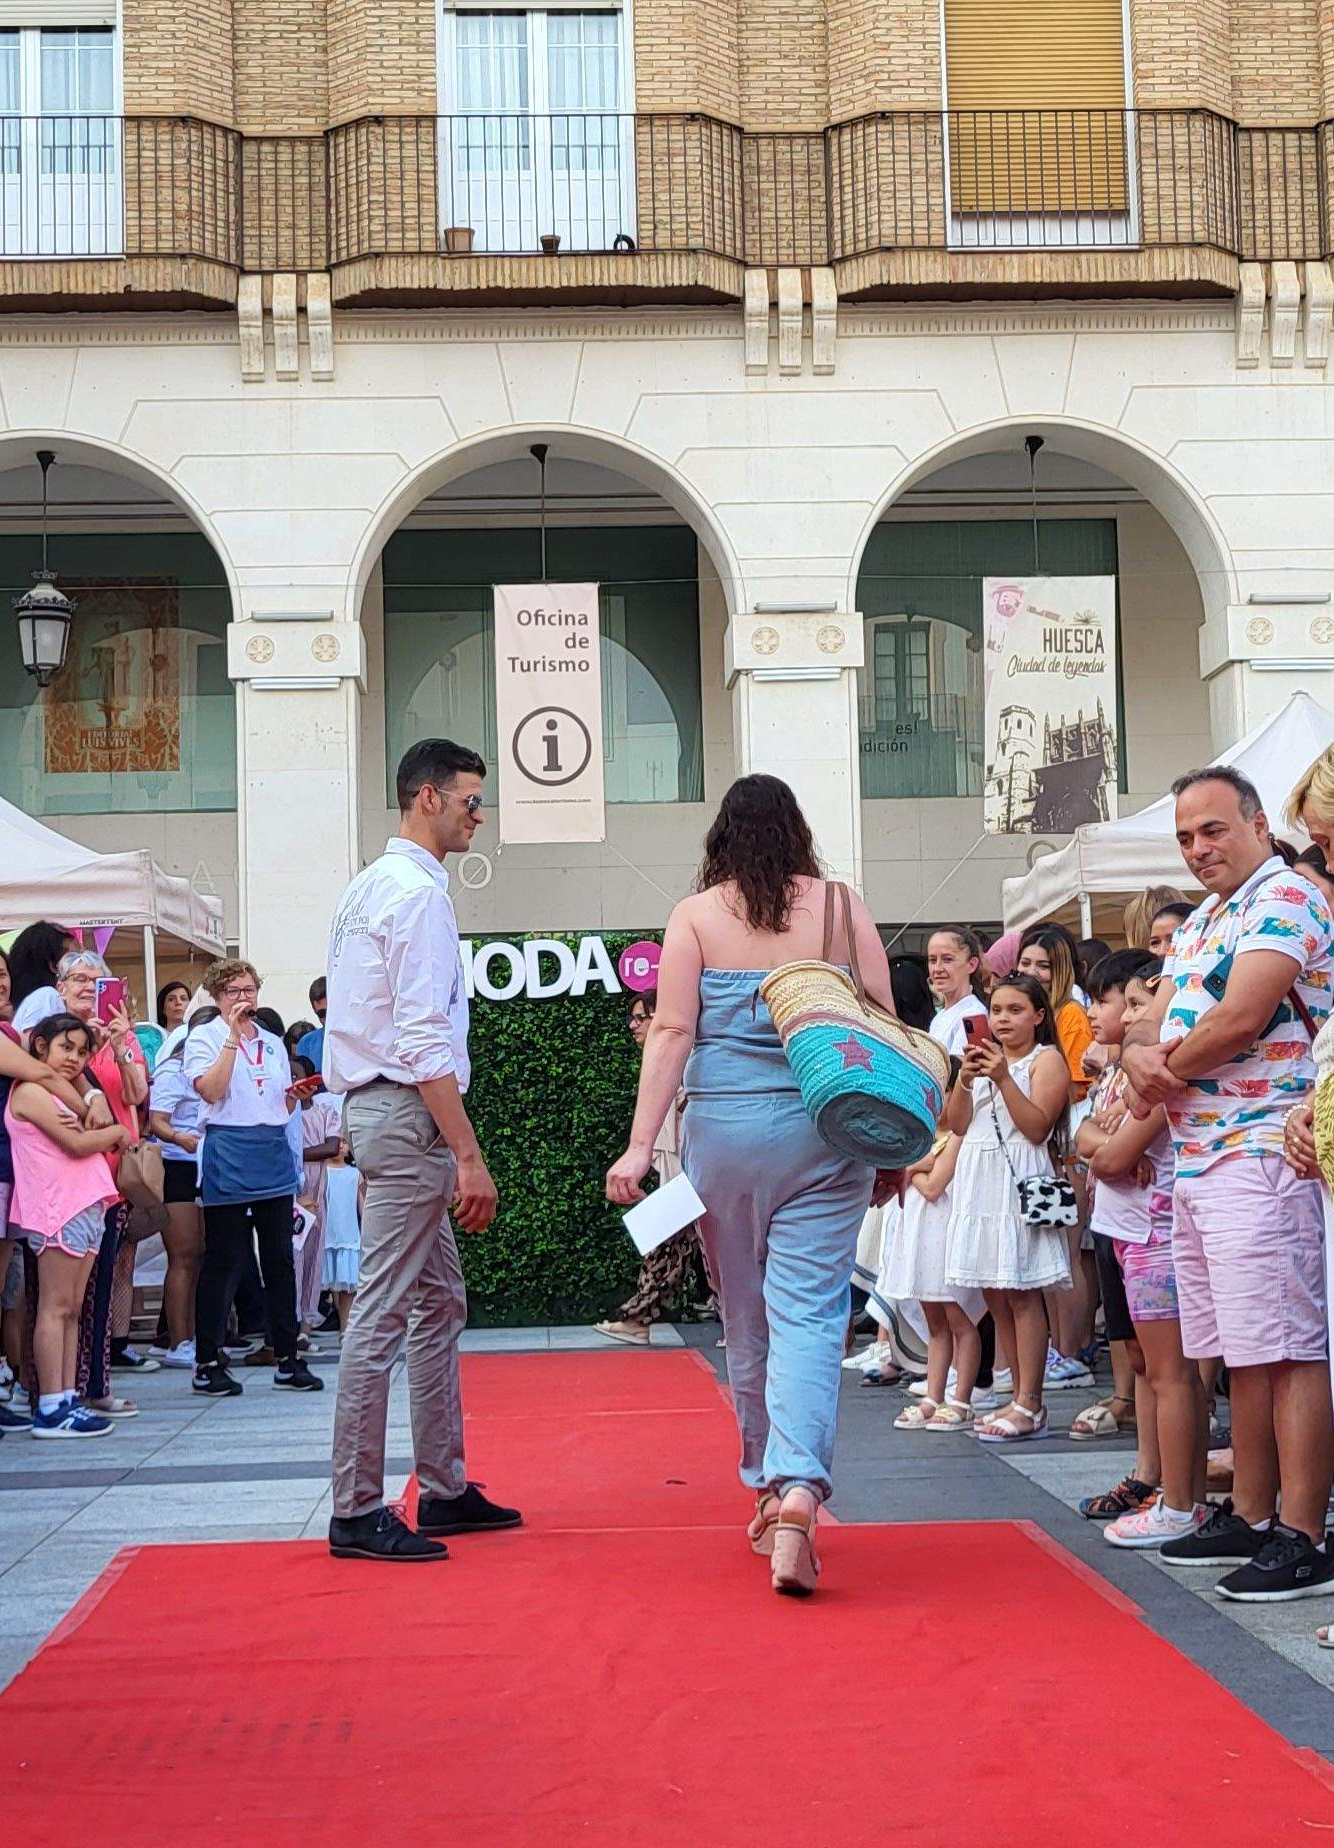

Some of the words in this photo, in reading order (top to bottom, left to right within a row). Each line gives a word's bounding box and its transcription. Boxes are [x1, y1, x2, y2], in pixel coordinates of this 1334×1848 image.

[516, 609, 589, 627] Oficina
[564, 632, 590, 650] de
[1043, 627, 1105, 654] HUESCA
[507, 656, 590, 674] Turismo
[1007, 654, 1046, 678] Ciudad
[1047, 656, 1061, 674] de
[1063, 656, 1107, 680] leyendas
[459, 936, 623, 1001] ODA
